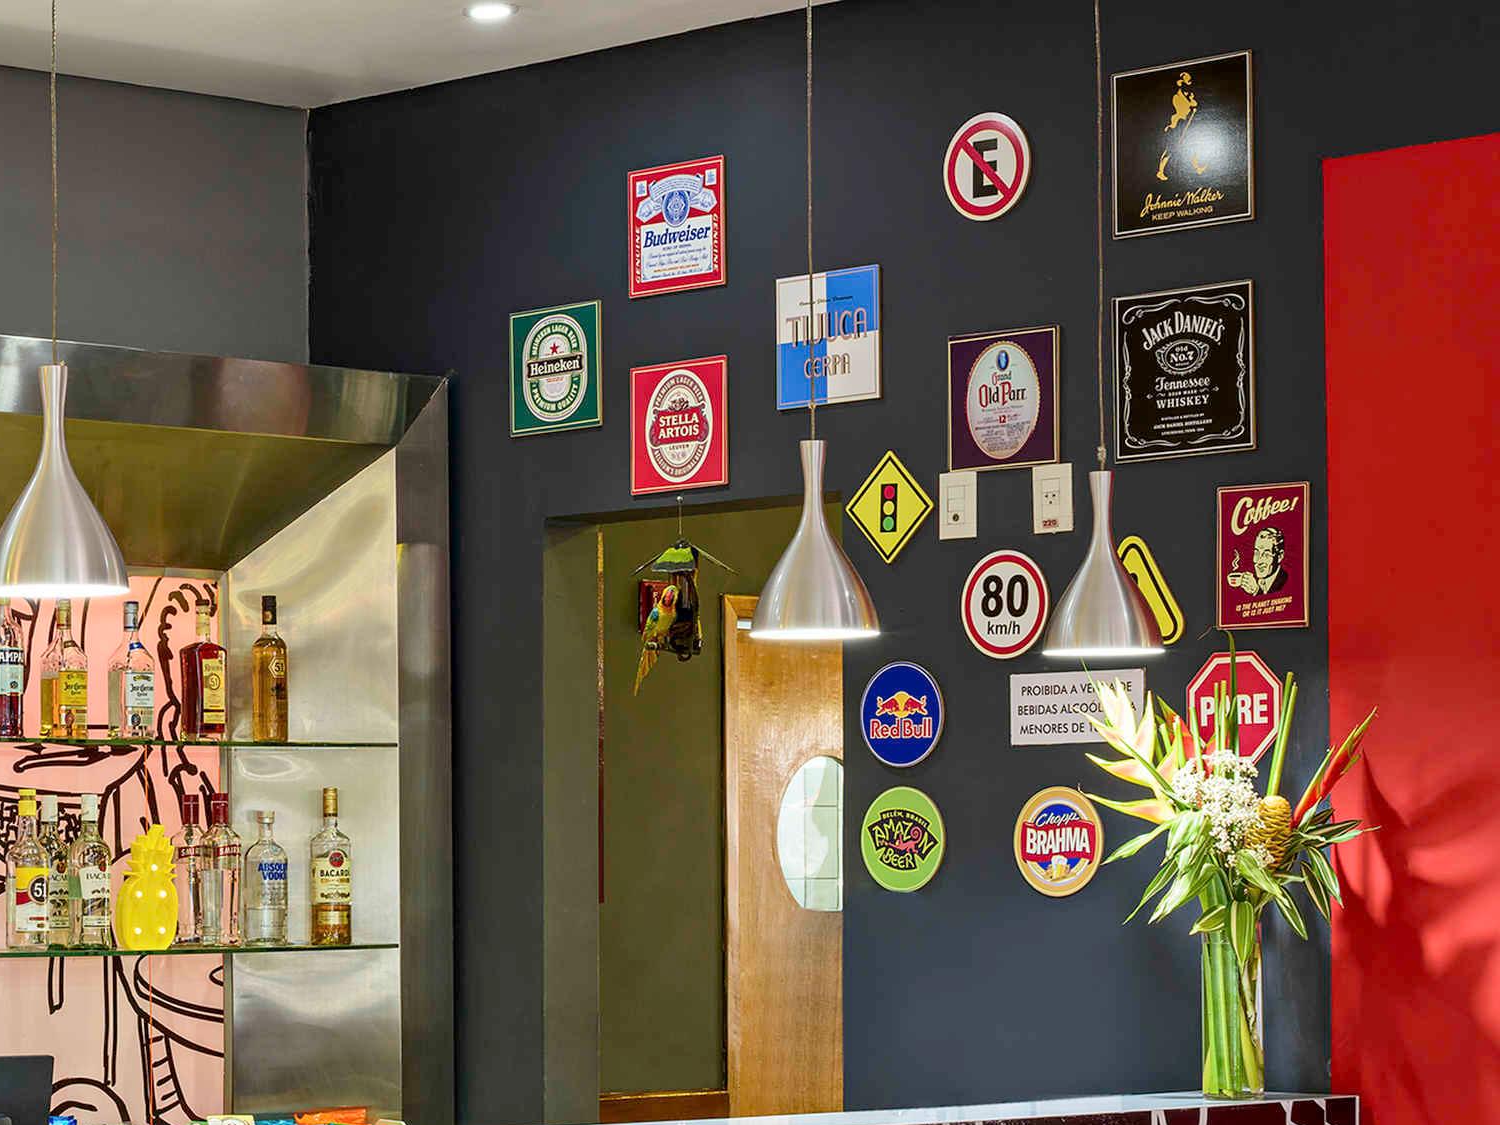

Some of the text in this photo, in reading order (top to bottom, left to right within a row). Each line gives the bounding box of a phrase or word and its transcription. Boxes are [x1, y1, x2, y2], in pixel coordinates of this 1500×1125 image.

[1140, 187, 1225, 218] Johnnie Walker
[1152, 205, 1213, 221] KEEP WALKING
[643, 224, 711, 249] Budweiser
[785, 307, 868, 348] TIJUCA
[1141, 317, 1174, 351] JACK
[530, 358, 580, 377] Heineken
[803, 352, 851, 379] CERPA
[1154, 376, 1211, 391] Tennessee
[979, 381, 1027, 408] Old Parr
[1156, 394, 1210, 410] WHISKEY
[658, 412, 699, 427] STELLA
[658, 424, 700, 440] ARTOIS
[1231, 496, 1299, 535] Coffee!
[981, 574, 1029, 618] 80
[987, 620, 1021, 635] km/h
[1021, 684, 1068, 697] PROIBIDA
[1070, 684, 1078, 695] A
[1018, 704, 1058, 716] BEBIDAS
[1060, 699, 1104, 715] ALCOÓL
[1200, 692, 1269, 727] PRE
[870, 717, 933, 739] Red Bull
[1020, 723, 1069, 735] MENORES
[1071, 722, 1085, 734] DE
[1036, 812, 1080, 827] Chopp
[872, 818, 935, 855] AMAZON
[1026, 826, 1091, 855] BRAHMA
[882, 848, 915, 869] BEER
